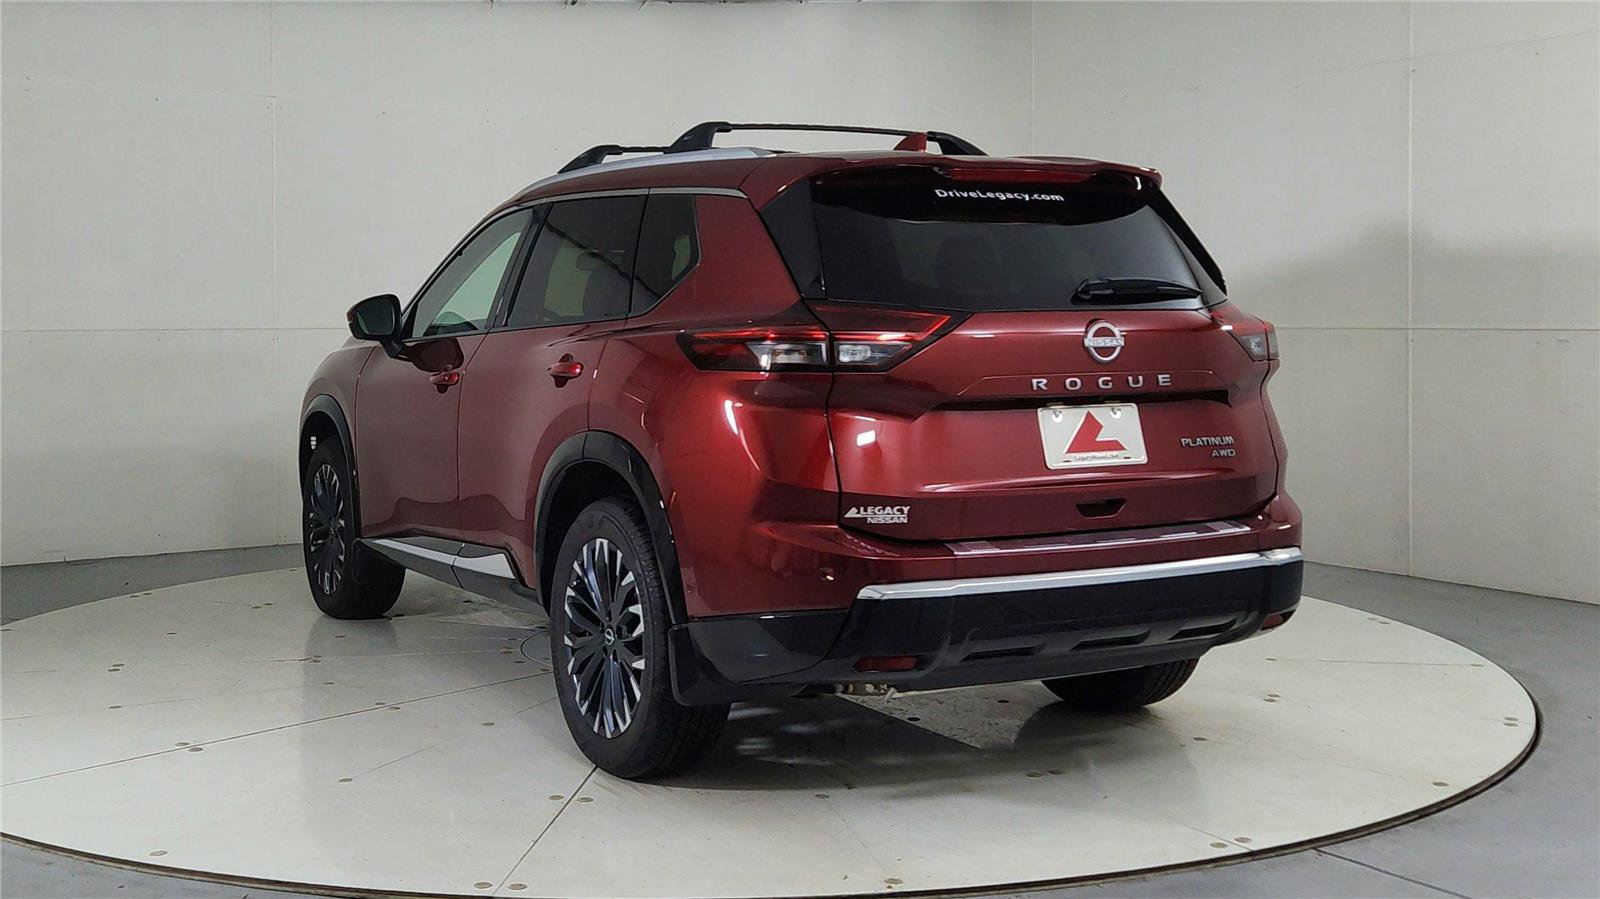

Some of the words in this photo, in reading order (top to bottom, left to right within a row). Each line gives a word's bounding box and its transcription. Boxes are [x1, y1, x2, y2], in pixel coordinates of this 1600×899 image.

[935, 189, 1064, 201] DriveLegacy.com
[1086, 337, 1124, 347] NISSAN
[1031, 374, 1172, 391] ROGUE
[1181, 436, 1235, 447] PLATINUM
[1211, 448, 1236, 458] AWD
[859, 506, 911, 515] LEGACY
[866, 516, 908, 524] NISSAN
